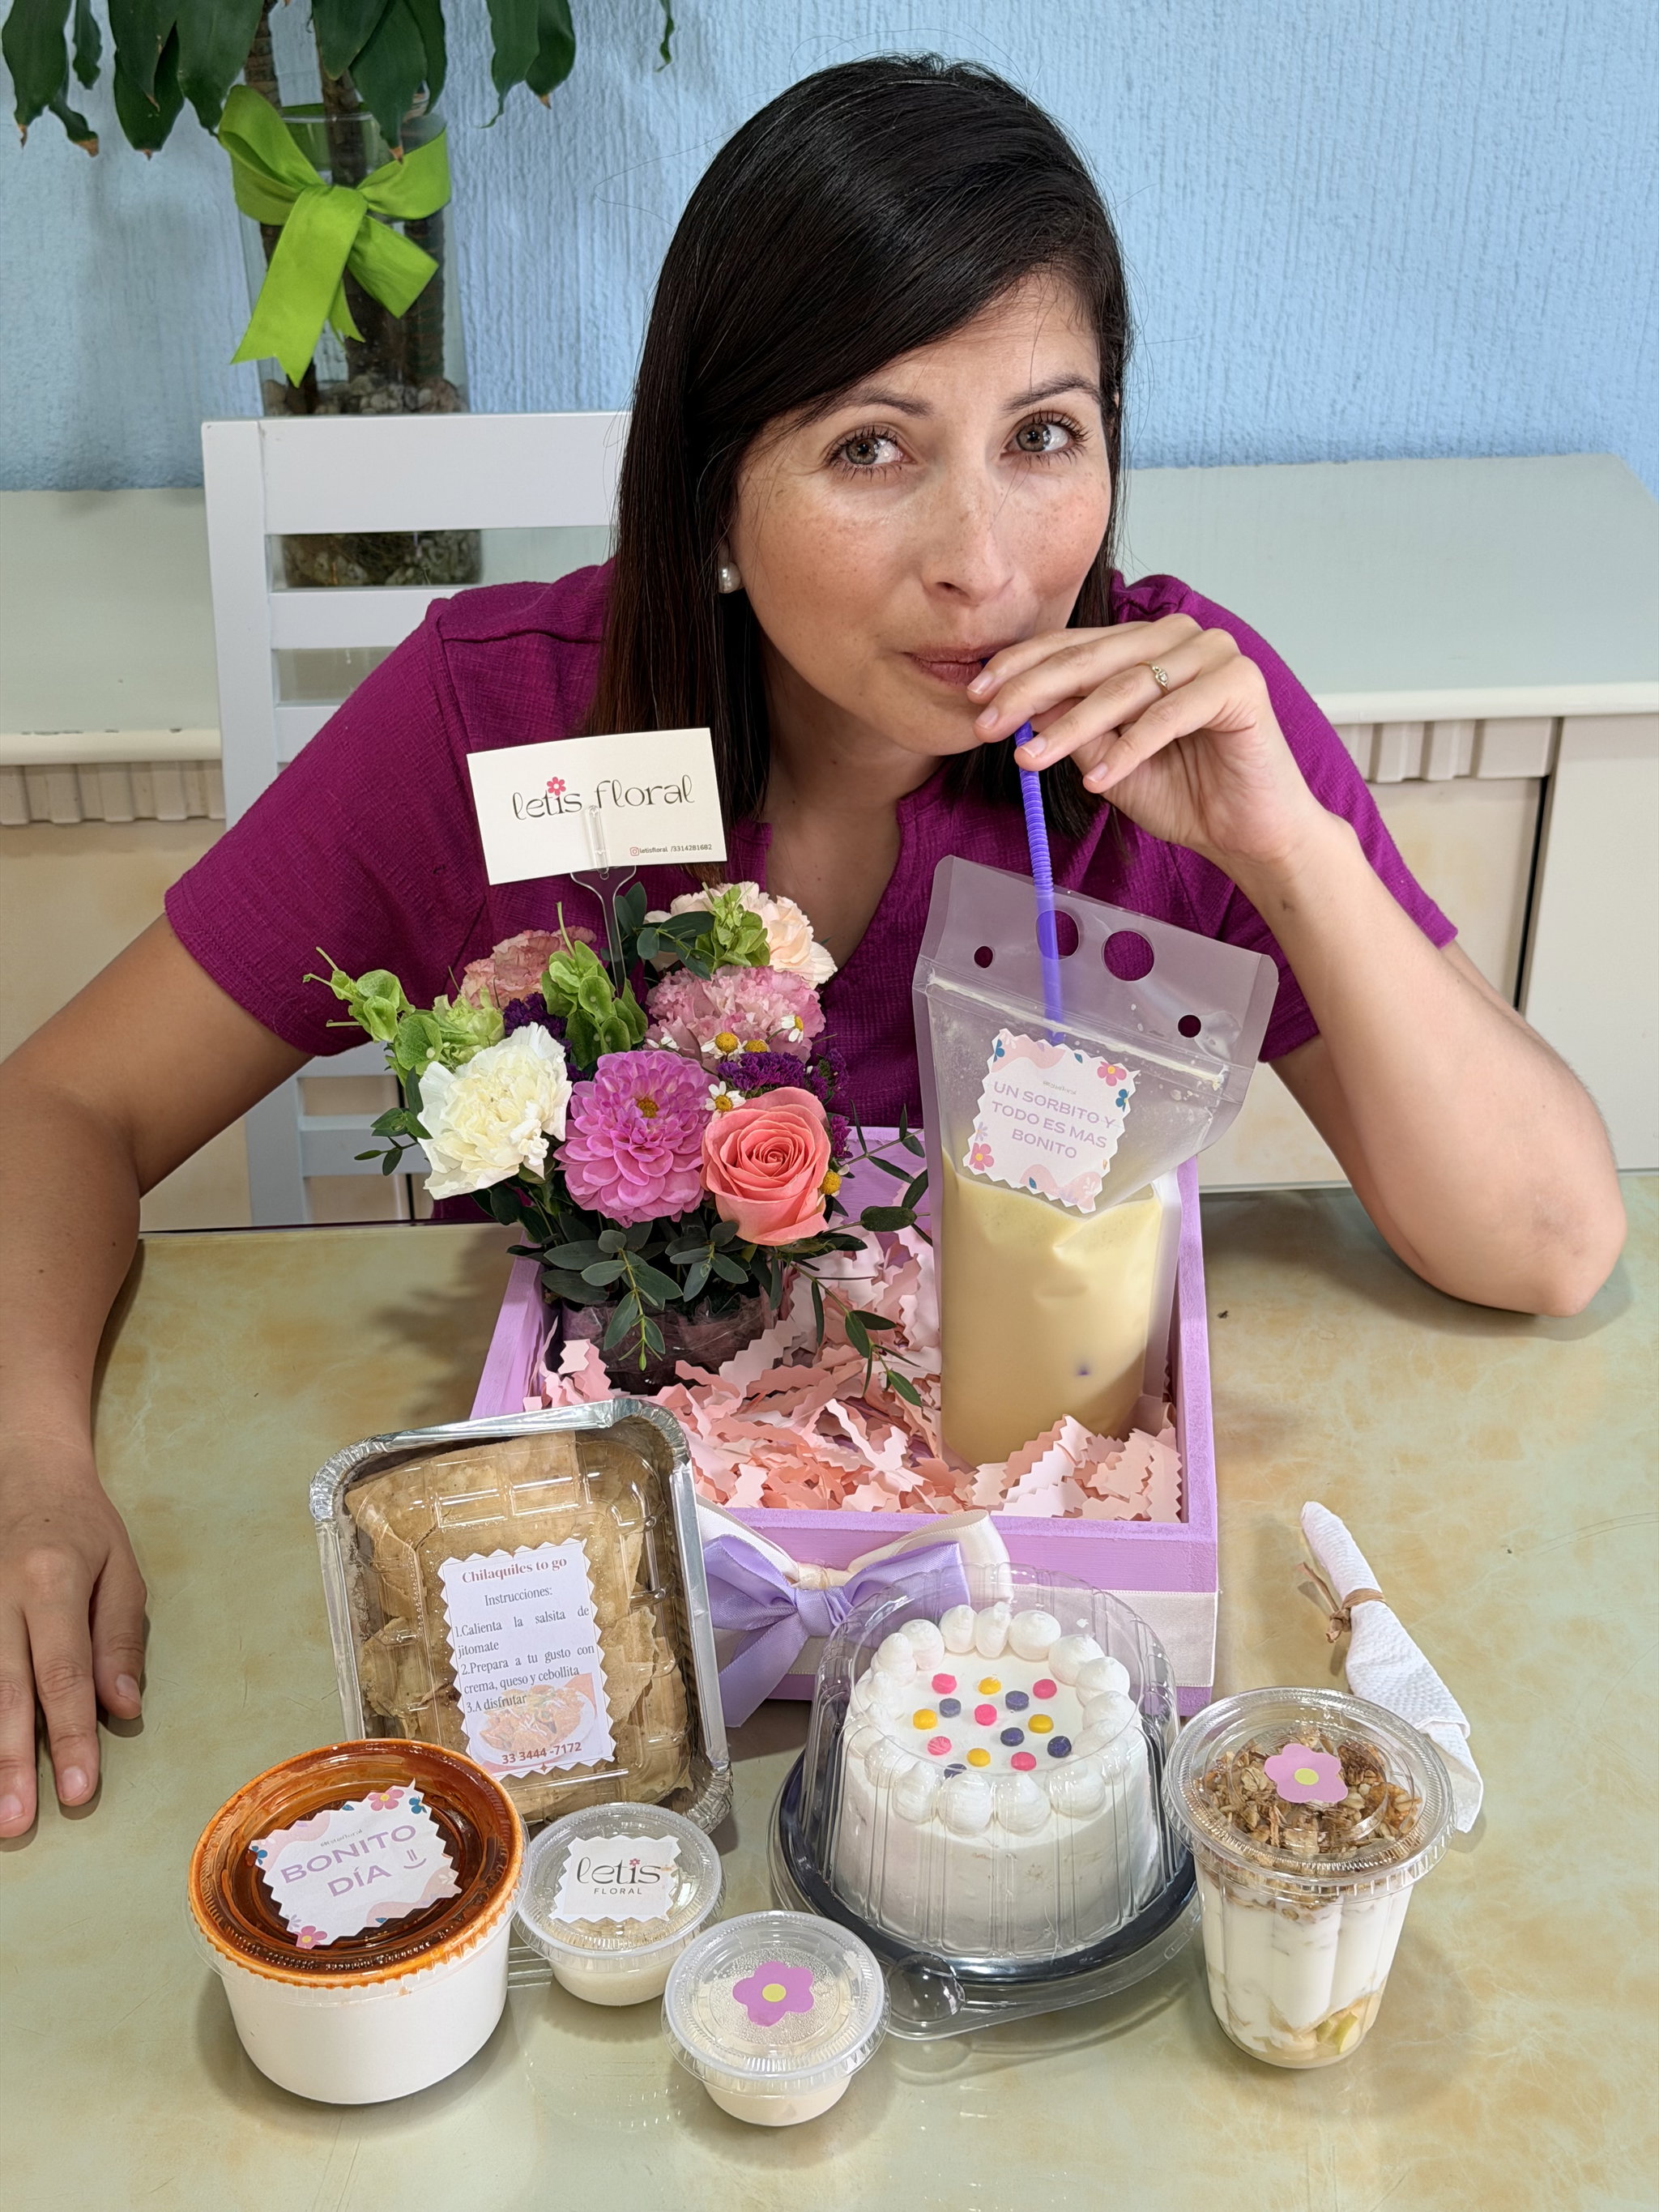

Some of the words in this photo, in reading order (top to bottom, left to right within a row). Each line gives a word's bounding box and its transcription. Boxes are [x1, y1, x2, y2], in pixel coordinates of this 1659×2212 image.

[512, 777, 582, 820] letis
[593, 774, 695, 808] floral
[993, 1080, 1019, 1099] UN
[1022, 1091, 1099, 1124] SORBITO
[1104, 1115, 1115, 1129] Y
[992, 1101, 1039, 1125] TODO
[1043, 1118, 1065, 1134] ES
[1069, 1127, 1107, 1149] MAS
[1012, 1128, 1077, 1159] BONITO
[462, 1562, 533, 1584] Chilaquiles
[535, 1560, 548, 1571] to
[552, 1558, 567, 1573] go
[484, 1586, 553, 1607] Instrucciones:
[454, 1620, 503, 1638] 1.Calienta
[514, 1616, 523, 1628] la
[535, 1609, 566, 1625] salsita
[577, 1606, 590, 1618] de
[457, 1640, 500, 1660] jitomate
[460, 1658, 509, 1677] 2.Prepara
[514, 1656, 522, 1666] a
[527, 1652, 538, 1664] tu
[544, 1647, 571, 1664] gusto
[577, 1644, 595, 1657] con
[463, 1680, 498, 1695] crema,
[499, 1675, 528, 1693] queso
[530, 1674, 536, 1686] y
[538, 1665, 580, 1681] cebollita
[466, 1700, 482, 1714] 3.A
[484, 1692, 527, 1711] disfrutar
[501, 1754, 518, 1765] 33
[518, 1749, 547, 1762] 3444
[549, 1741, 582, 1757] -7172
[280, 1824, 416, 1884] BONITO
[326, 1865, 393, 1897] DÍA
[576, 1856, 662, 1885] letis
[594, 1887, 642, 1895] FLORAL
